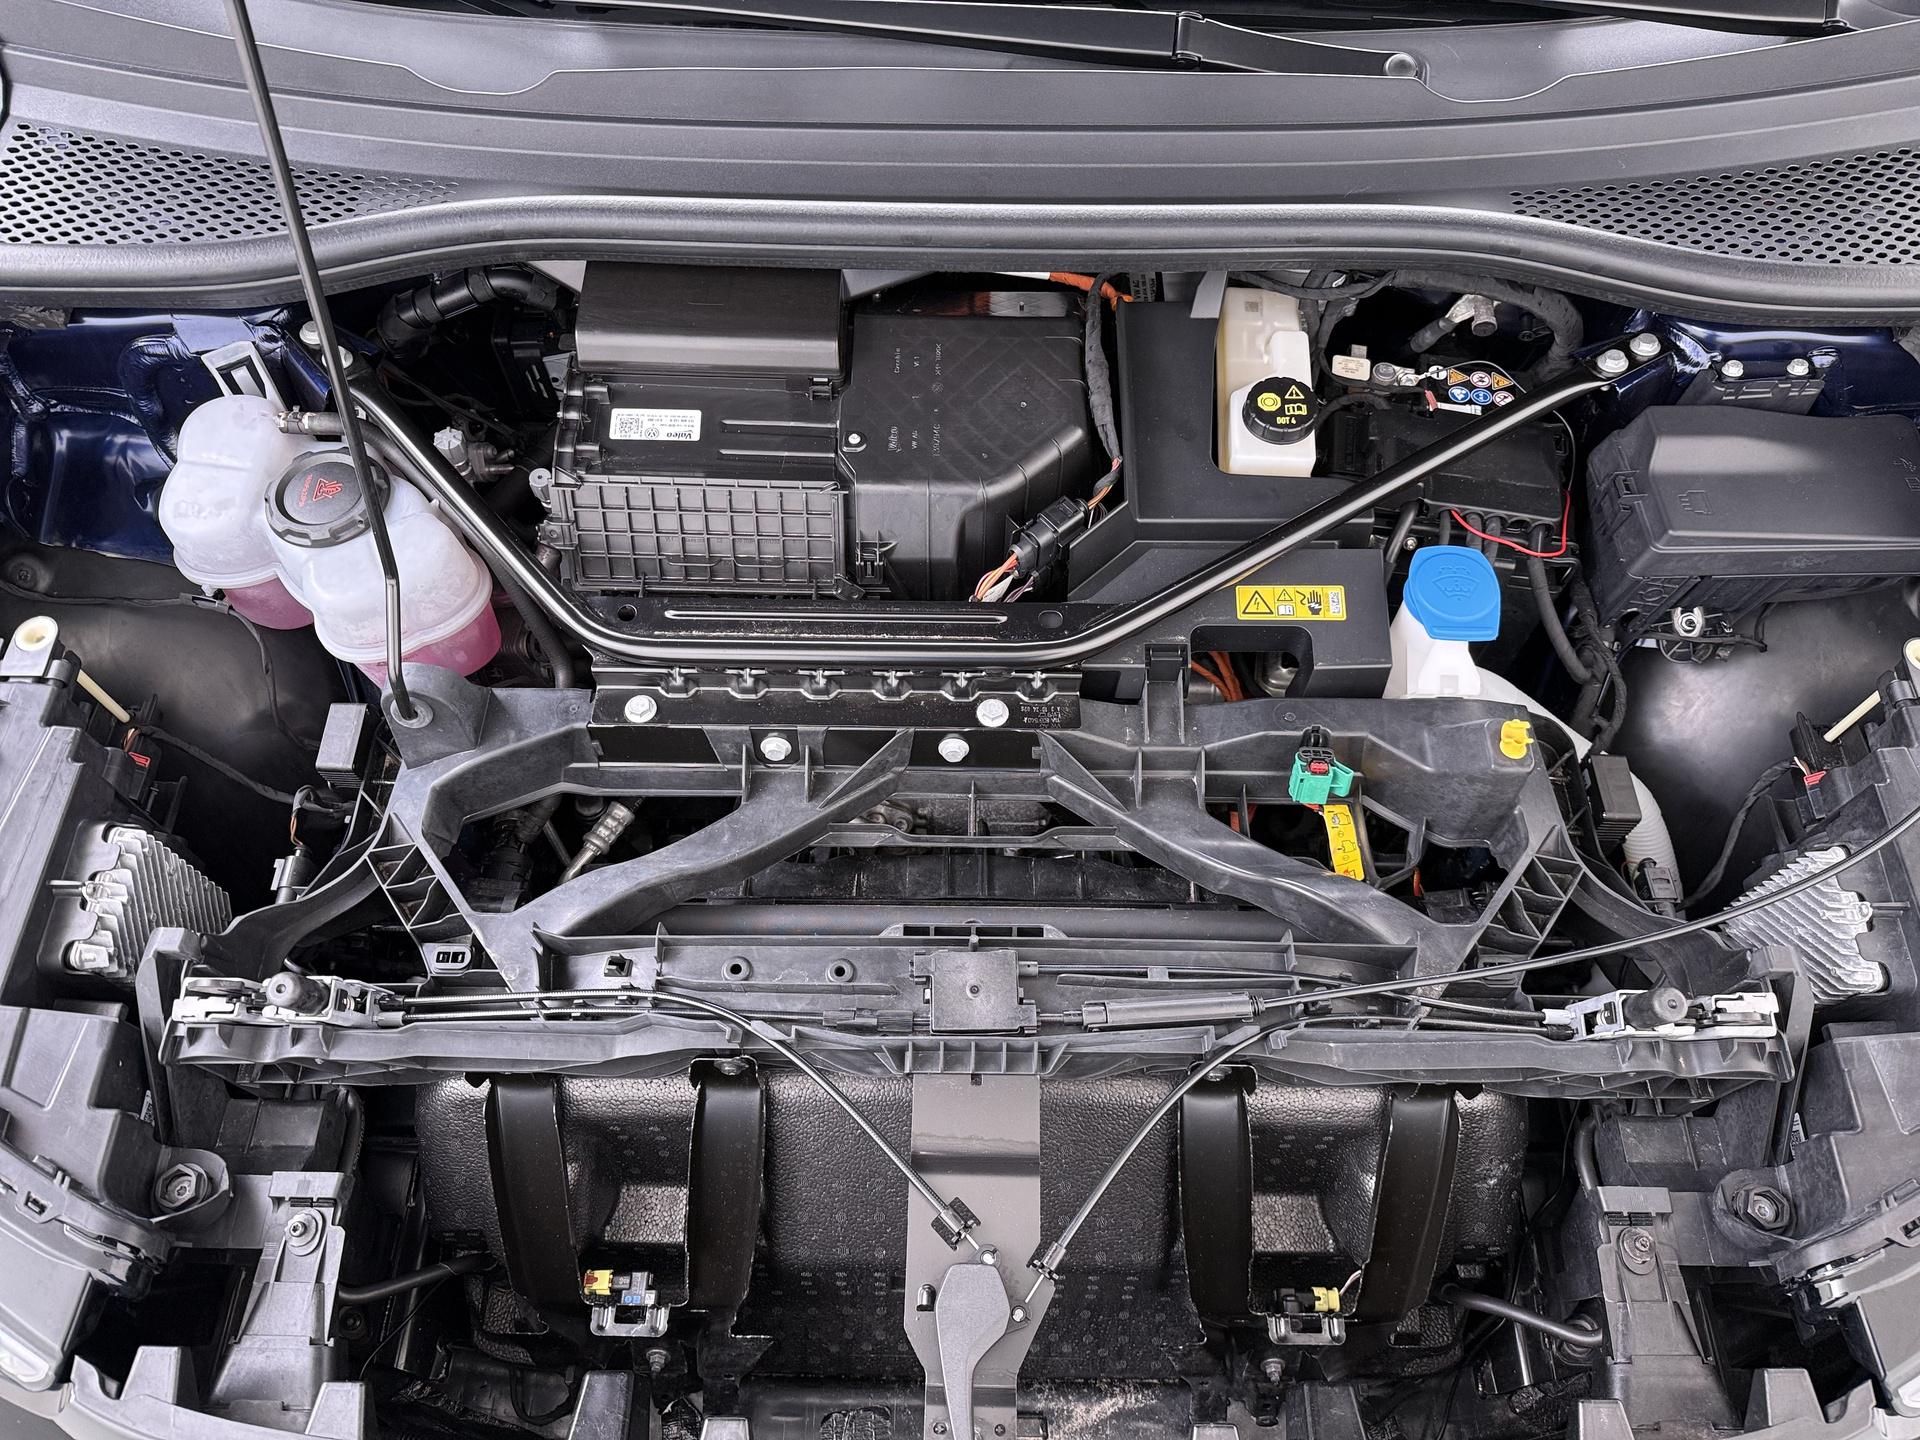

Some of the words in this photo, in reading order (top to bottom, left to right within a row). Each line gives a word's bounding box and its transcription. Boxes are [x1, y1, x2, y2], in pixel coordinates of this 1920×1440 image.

[1276, 416, 1290, 425] DOT
[1290, 416, 1297, 425] 4
[666, 429, 693, 440] Valeo
